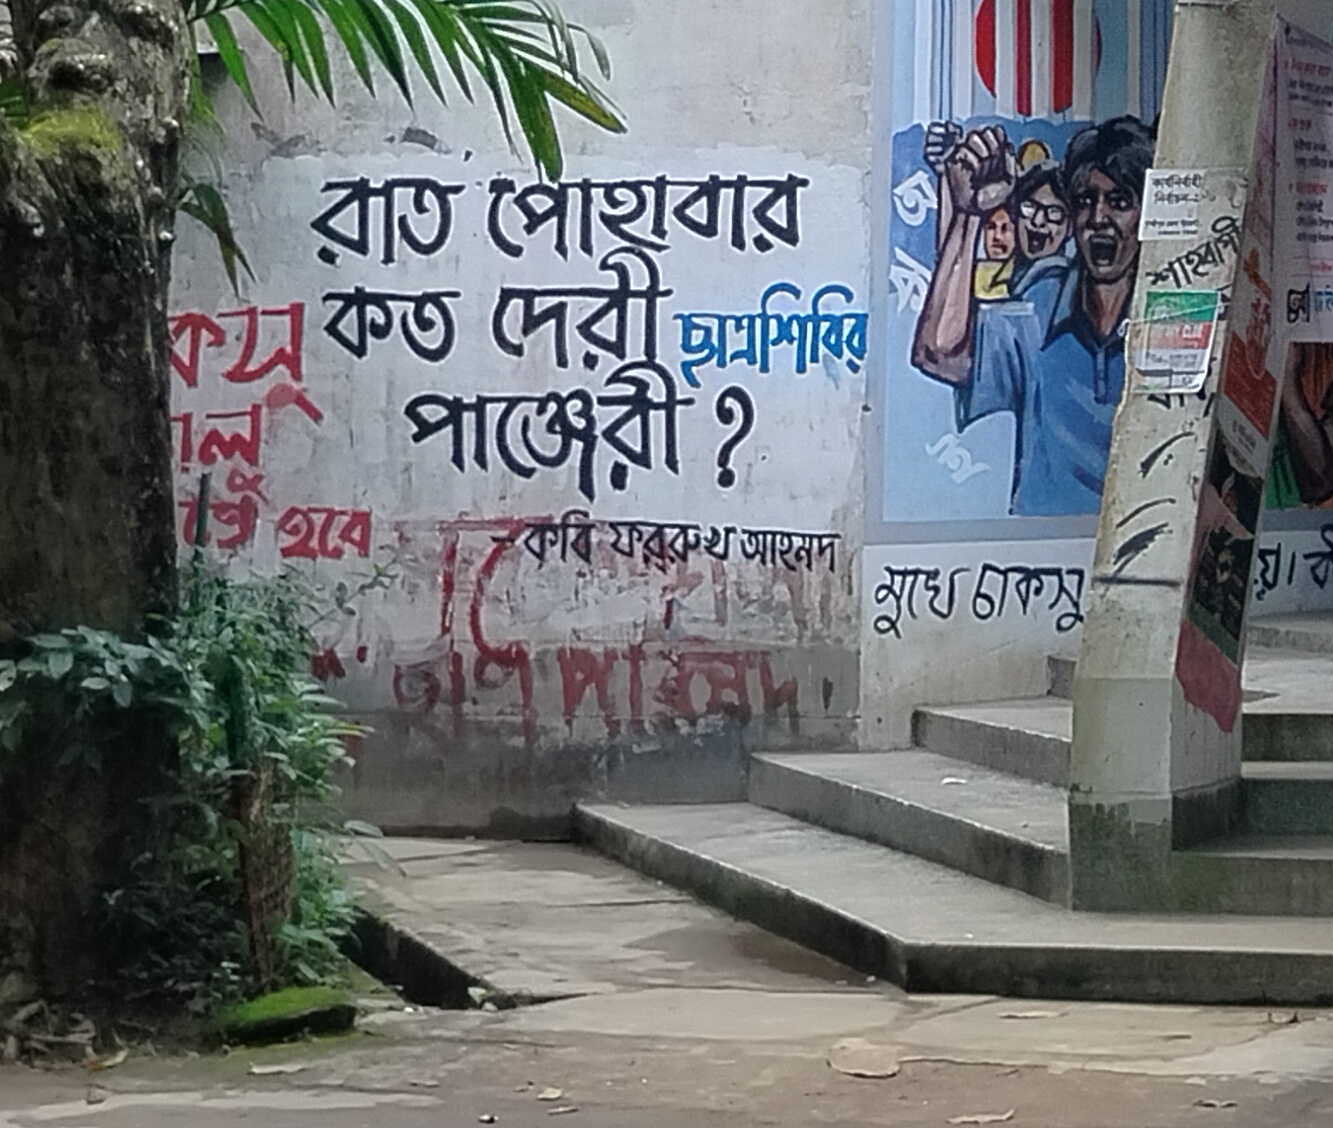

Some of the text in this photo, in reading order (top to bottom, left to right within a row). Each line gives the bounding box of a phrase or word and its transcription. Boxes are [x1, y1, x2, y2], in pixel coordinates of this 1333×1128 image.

[311, 174, 810, 265] রাত পোহাবার
[322, 245, 673, 368] কত দেরী
[673, 283, 868, 388] ছাত্রশিবির
[167, 302, 323, 424] কসু
[276, 505, 371, 560] হবে
[740, 526, 841, 574] আহমদ
